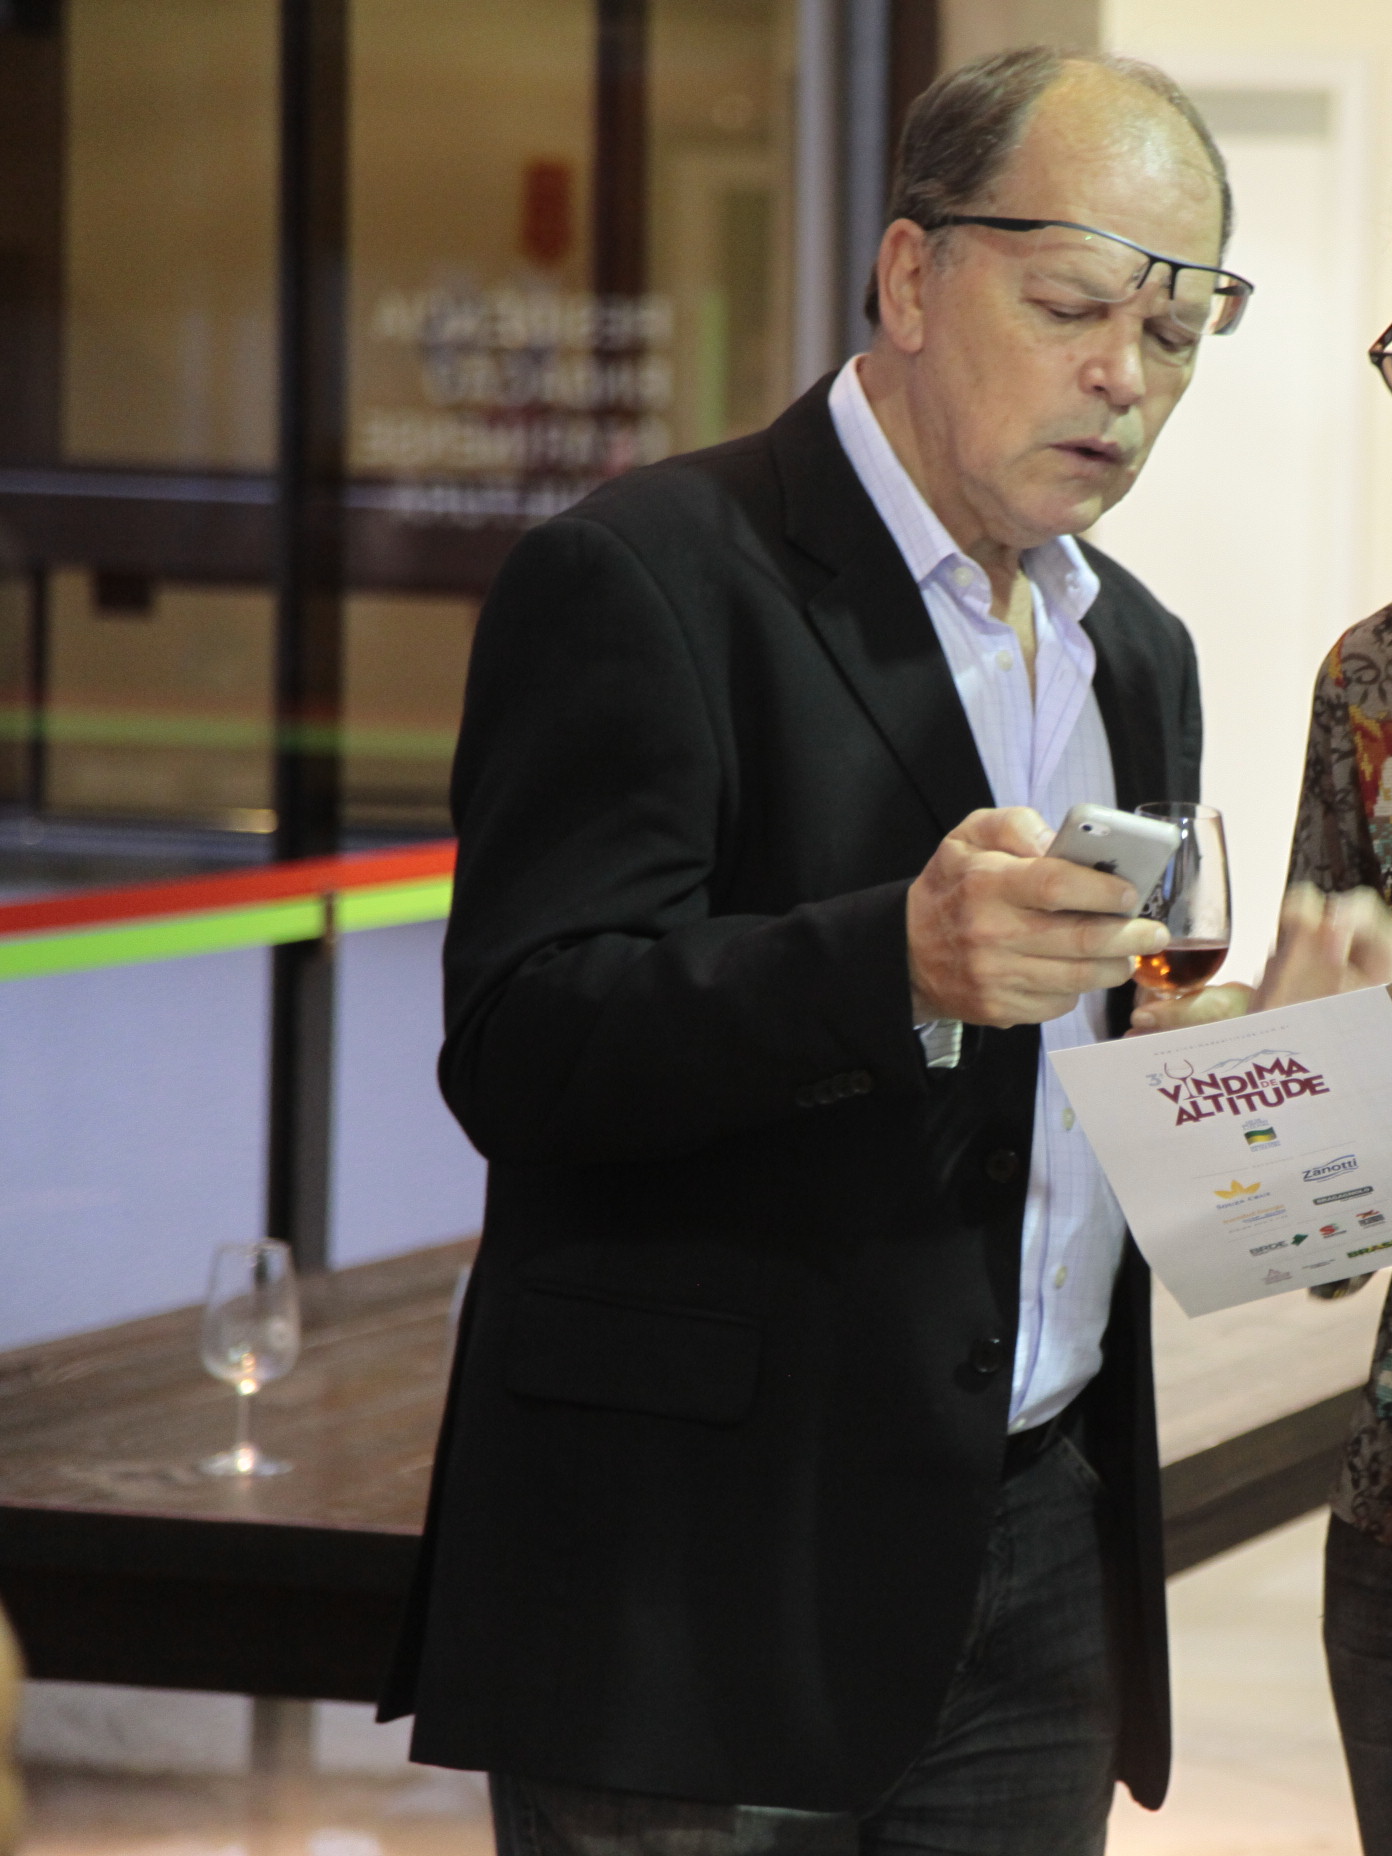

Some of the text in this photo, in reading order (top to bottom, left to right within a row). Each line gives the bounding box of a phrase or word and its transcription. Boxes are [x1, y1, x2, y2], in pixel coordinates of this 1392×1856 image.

[1261, 1079, 1278, 1088] DE
[1175, 1074, 1331, 1127] ALTITUDE
[1303, 1157, 1358, 1180] Zanotti
